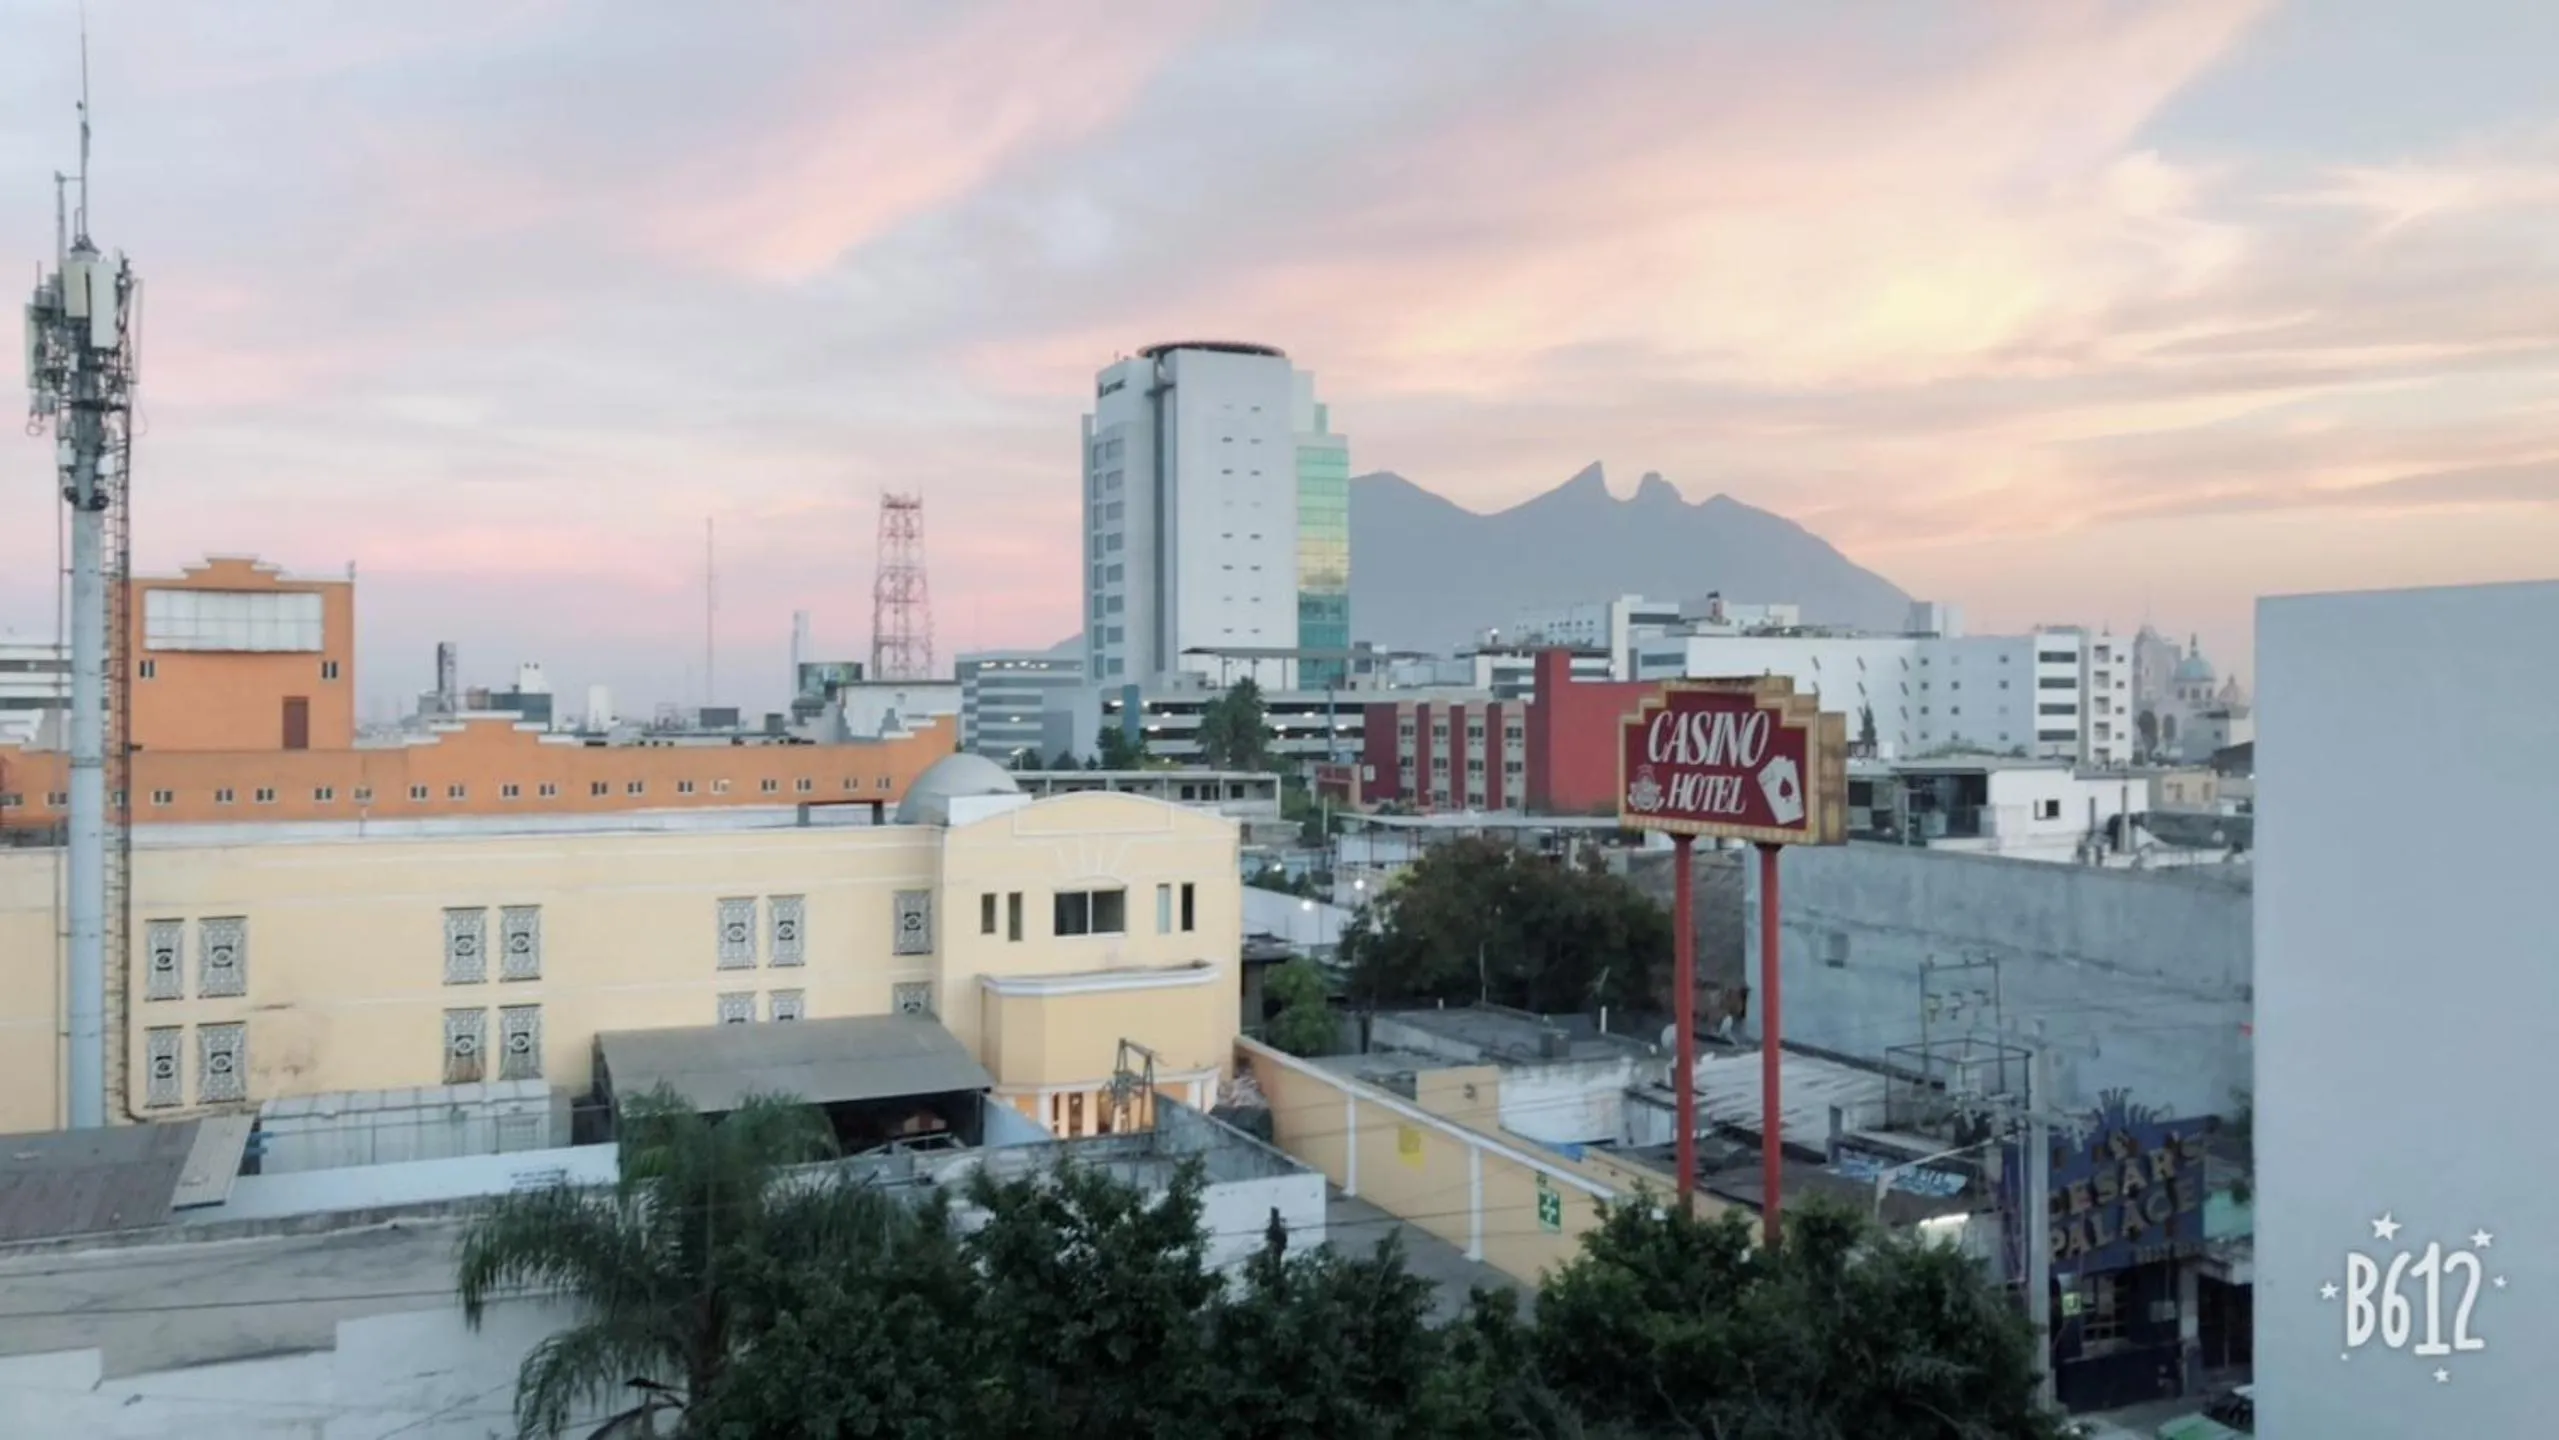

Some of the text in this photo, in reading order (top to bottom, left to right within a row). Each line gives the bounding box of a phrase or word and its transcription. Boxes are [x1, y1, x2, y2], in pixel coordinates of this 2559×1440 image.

[1648, 710, 1770, 768] CASINO
[1667, 772, 1747, 814] HOTEL
[2049, 1177, 2199, 1264] PALACE
